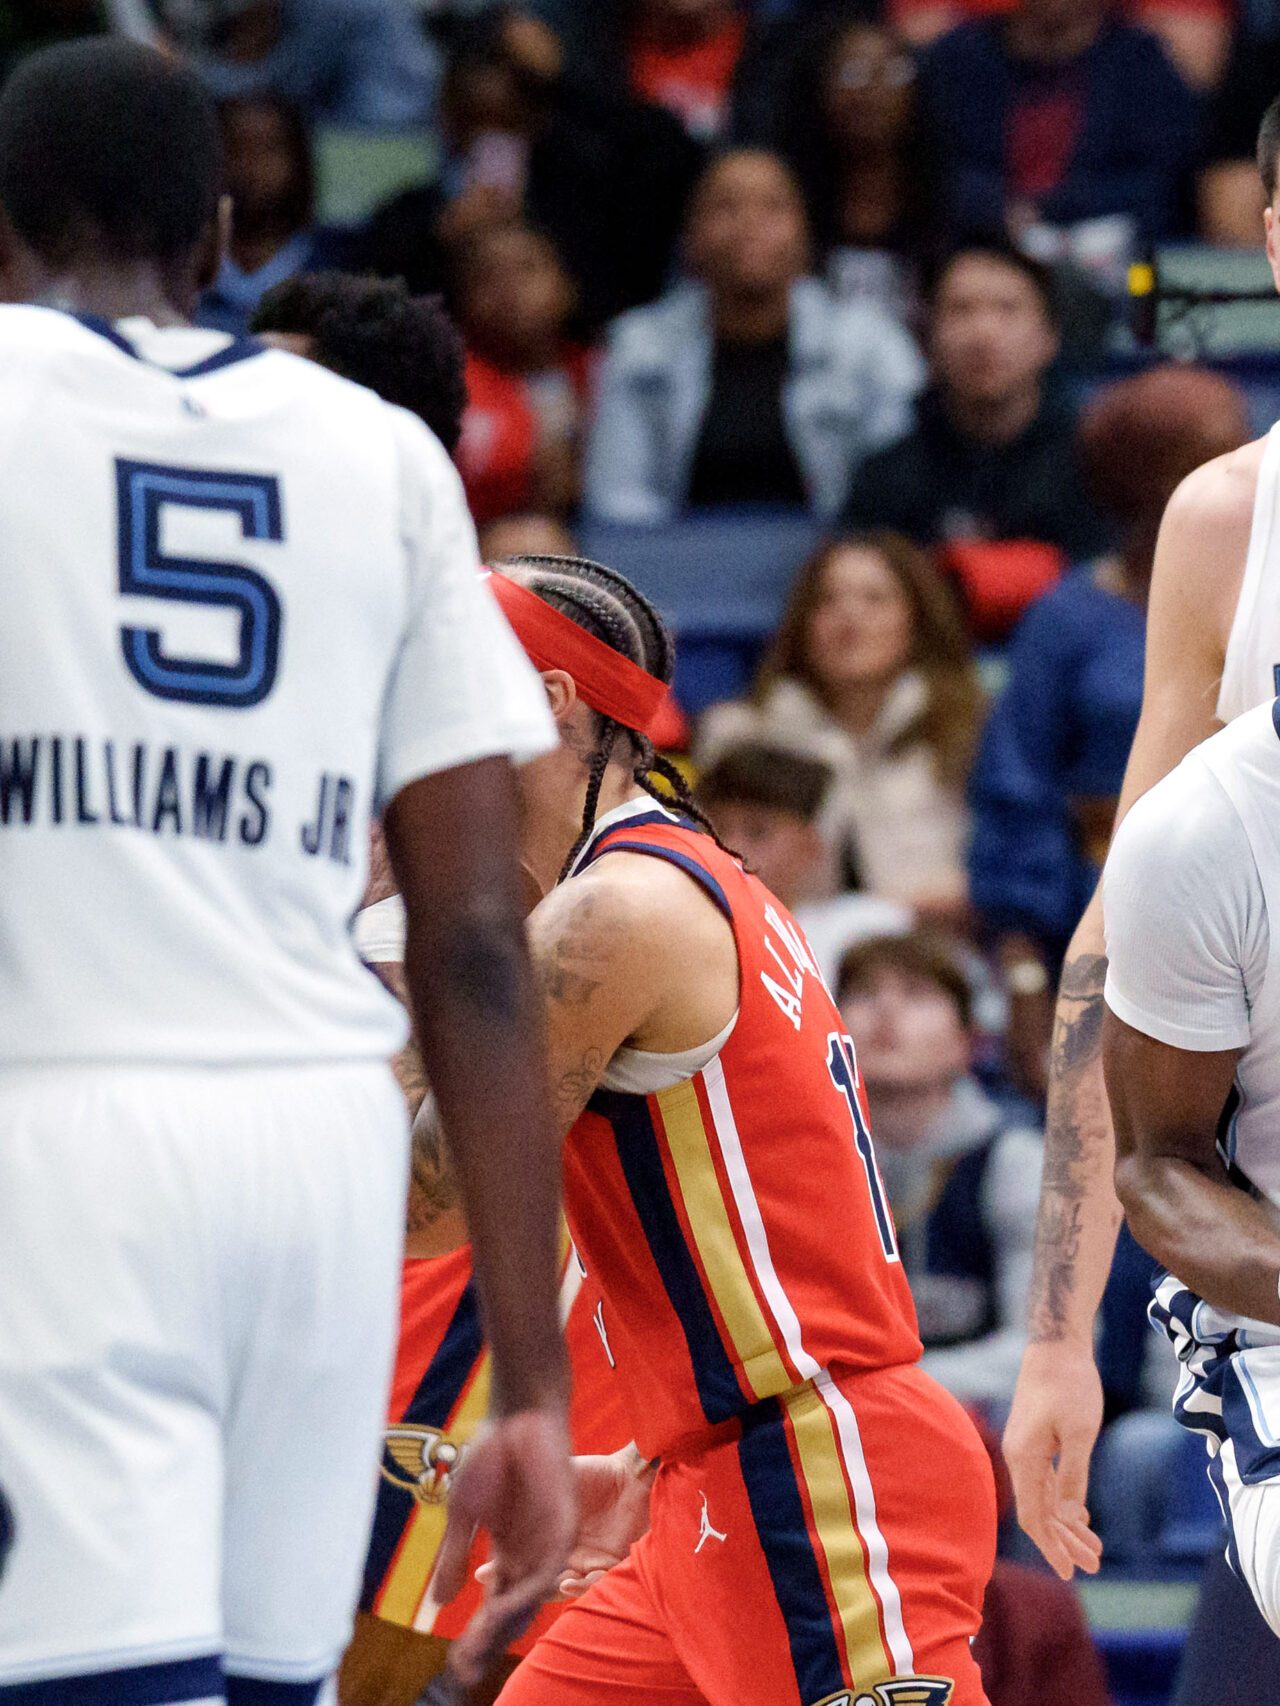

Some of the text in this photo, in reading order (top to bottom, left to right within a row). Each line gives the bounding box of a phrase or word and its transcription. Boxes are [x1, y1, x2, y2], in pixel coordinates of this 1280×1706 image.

[115, 456, 284, 708] 5
[0, 737, 353, 866] WILLIAMS JR
[826, 1031, 900, 1264] 1
